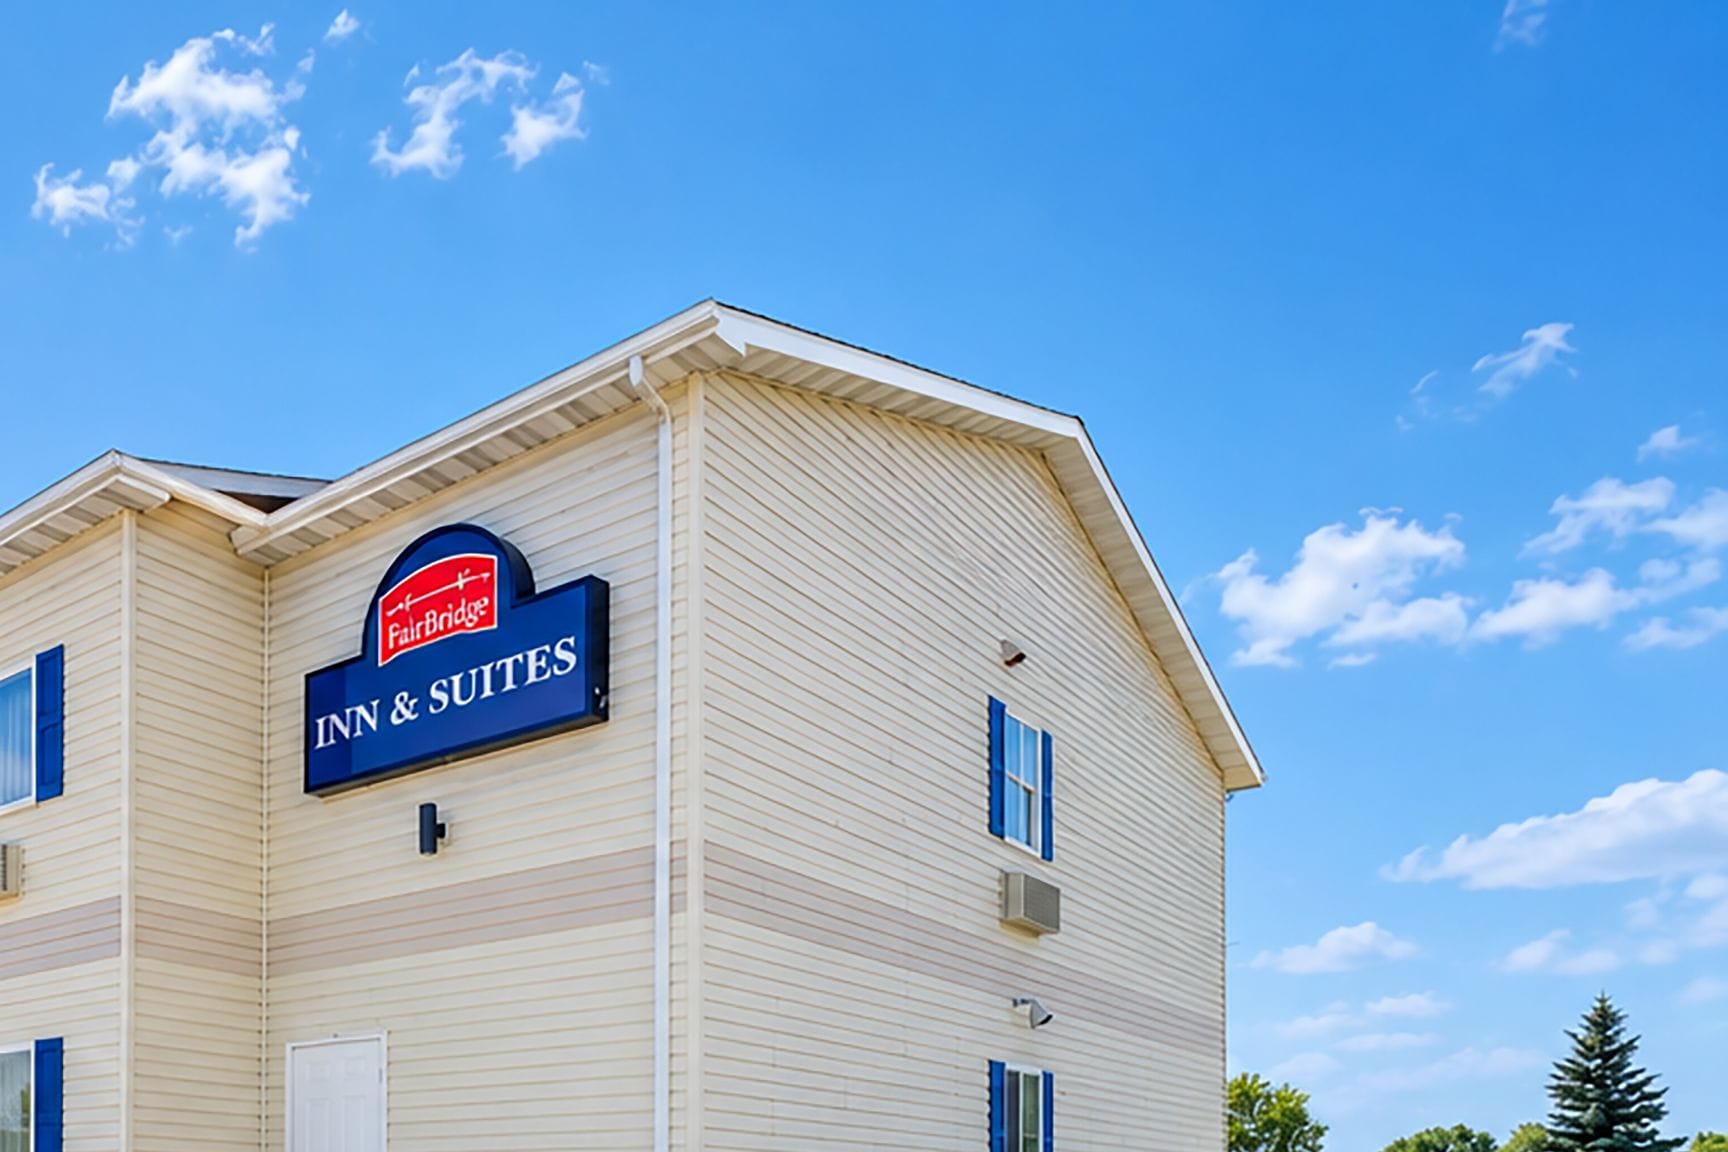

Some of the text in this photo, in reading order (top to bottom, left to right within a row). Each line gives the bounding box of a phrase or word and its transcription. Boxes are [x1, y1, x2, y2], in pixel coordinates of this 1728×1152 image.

[388, 597, 490, 650] FairBridge
[314, 636, 578, 750] INN & SUITES
